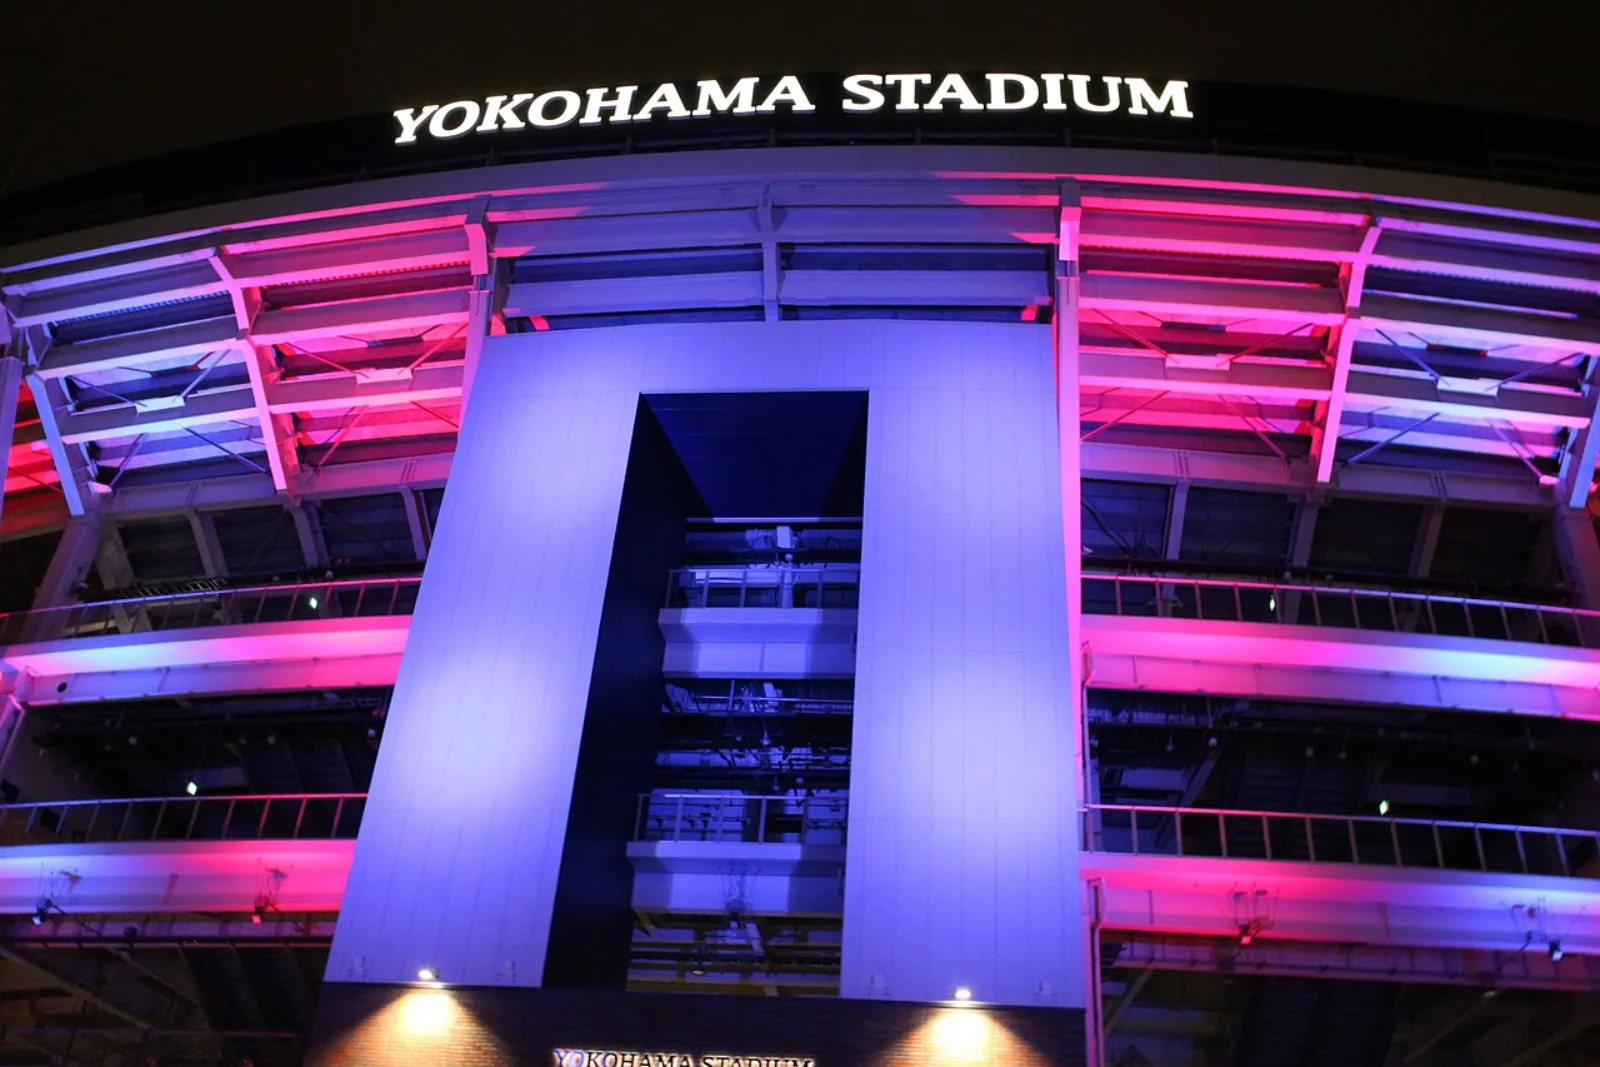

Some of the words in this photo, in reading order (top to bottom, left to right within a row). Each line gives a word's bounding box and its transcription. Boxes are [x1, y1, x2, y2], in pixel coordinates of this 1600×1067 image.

[393, 75, 815, 144] YOKOHAMA
[842, 73, 1194, 118] STADIUM
[553, 1049, 693, 1067] YOKOHAMA
